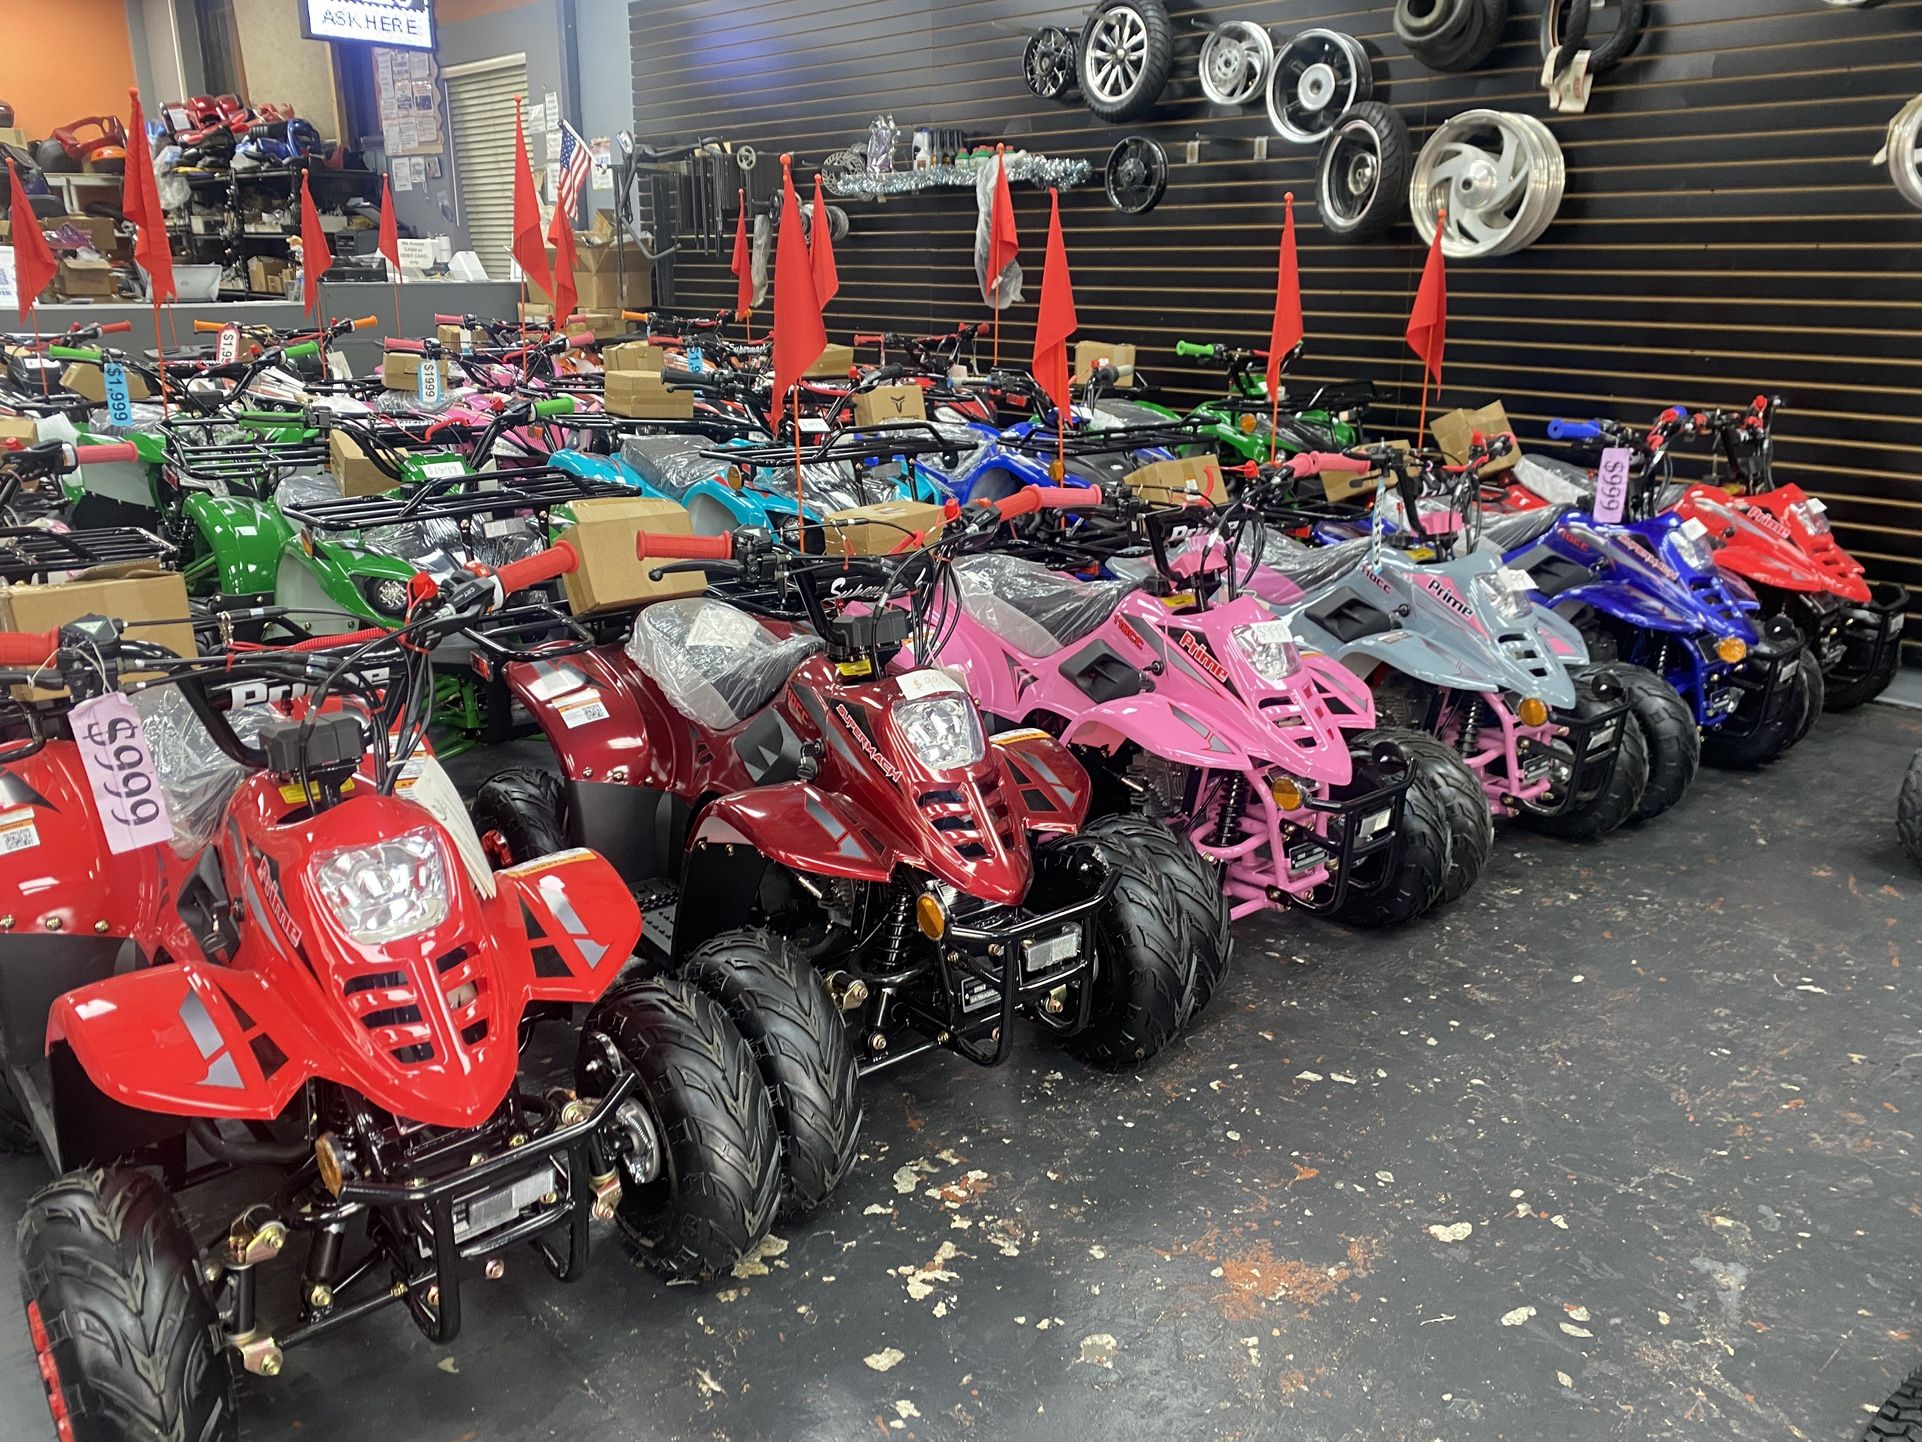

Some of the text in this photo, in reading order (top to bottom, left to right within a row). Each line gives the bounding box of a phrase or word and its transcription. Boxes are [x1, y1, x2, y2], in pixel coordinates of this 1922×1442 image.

[321, 8, 418, 35] ASK HERE
[107, 367, 129, 421] $1,999
[1600, 460, 1625, 511] $999
[1428, 578, 1474, 618] Prime
[1179, 630, 1230, 683] Prime
[835, 703, 903, 782] SUPERMACH
[82, 716, 160, 826] $999
